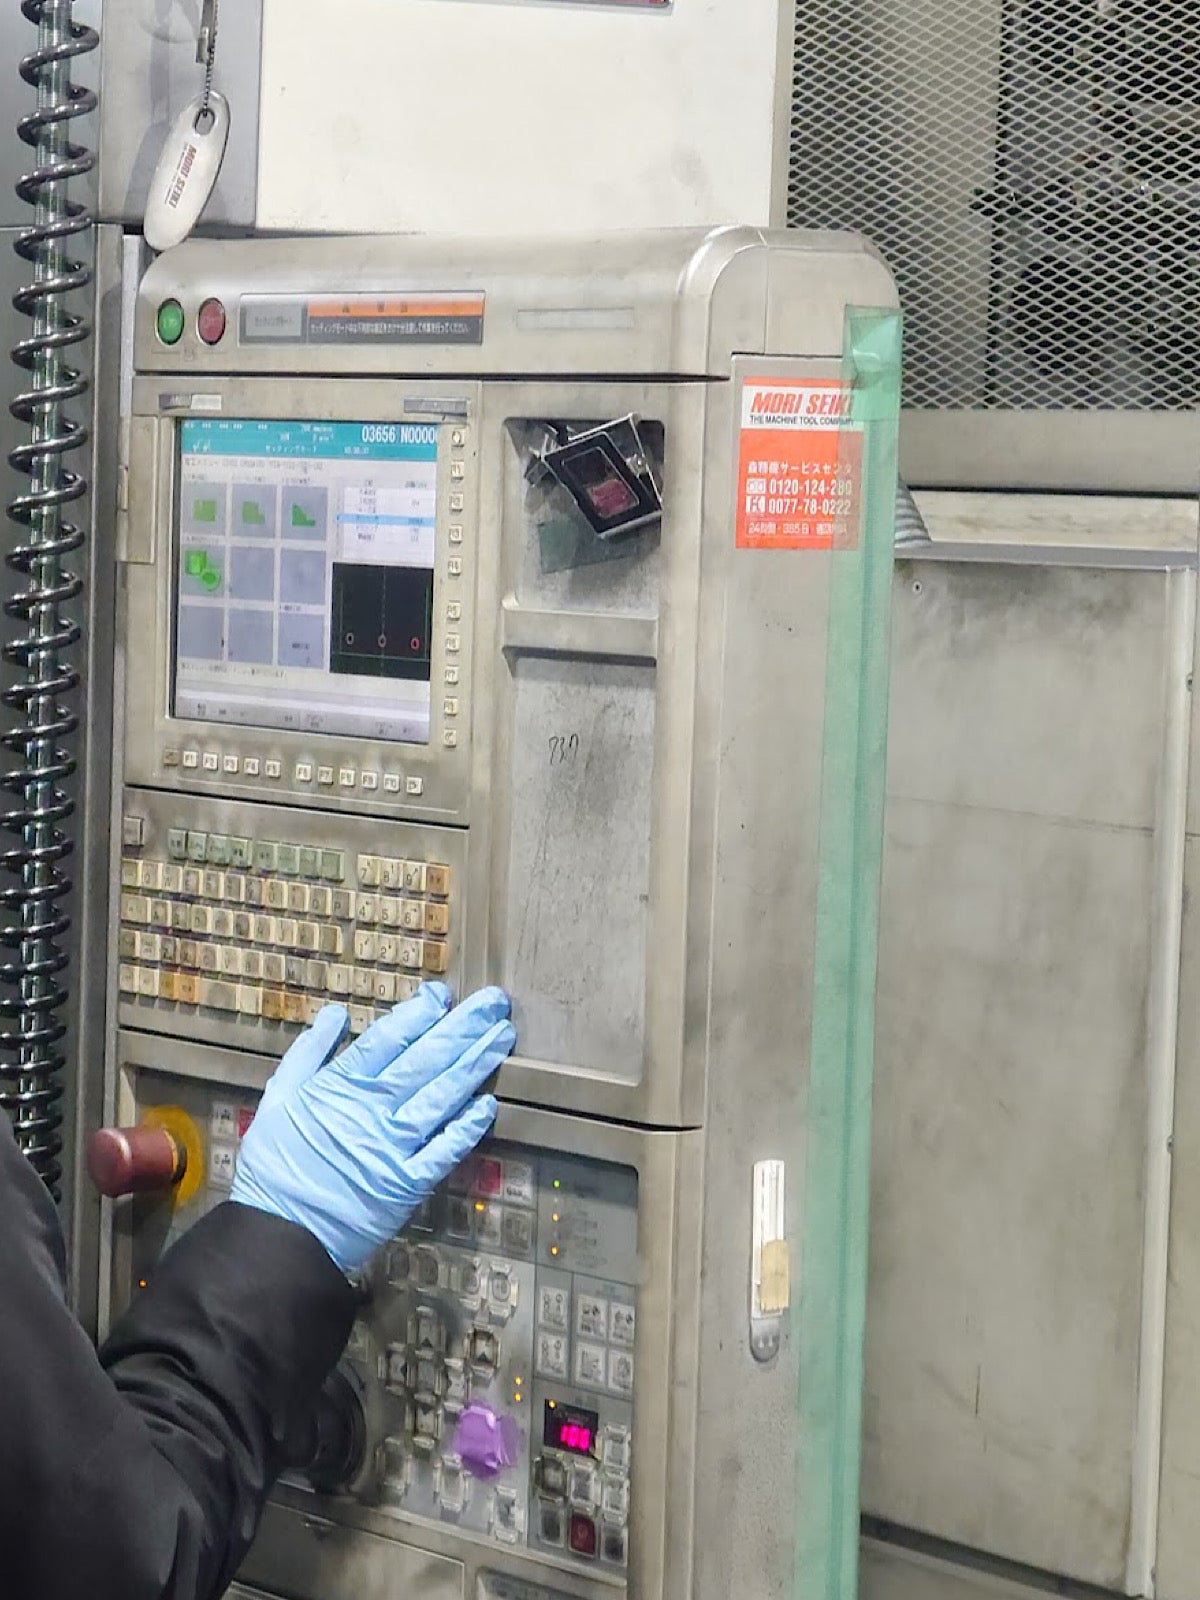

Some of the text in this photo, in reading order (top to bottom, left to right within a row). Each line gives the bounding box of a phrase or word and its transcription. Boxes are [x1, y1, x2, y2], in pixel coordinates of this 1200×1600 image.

[179, 144, 197, 178] MORI
[168, 179, 186, 209] SEIKI
[751, 392, 801, 414] MORI
[750, 415, 764, 424] THE
[766, 416, 798, 425] MACHINE
[800, 417, 818, 425] TOOL
[361, 867, 413, 887] 7 8 9
[358, 904, 412, 925] 4 5 6
[380, 945, 388, 959] 2
[402, 949, 410, 962] 3
